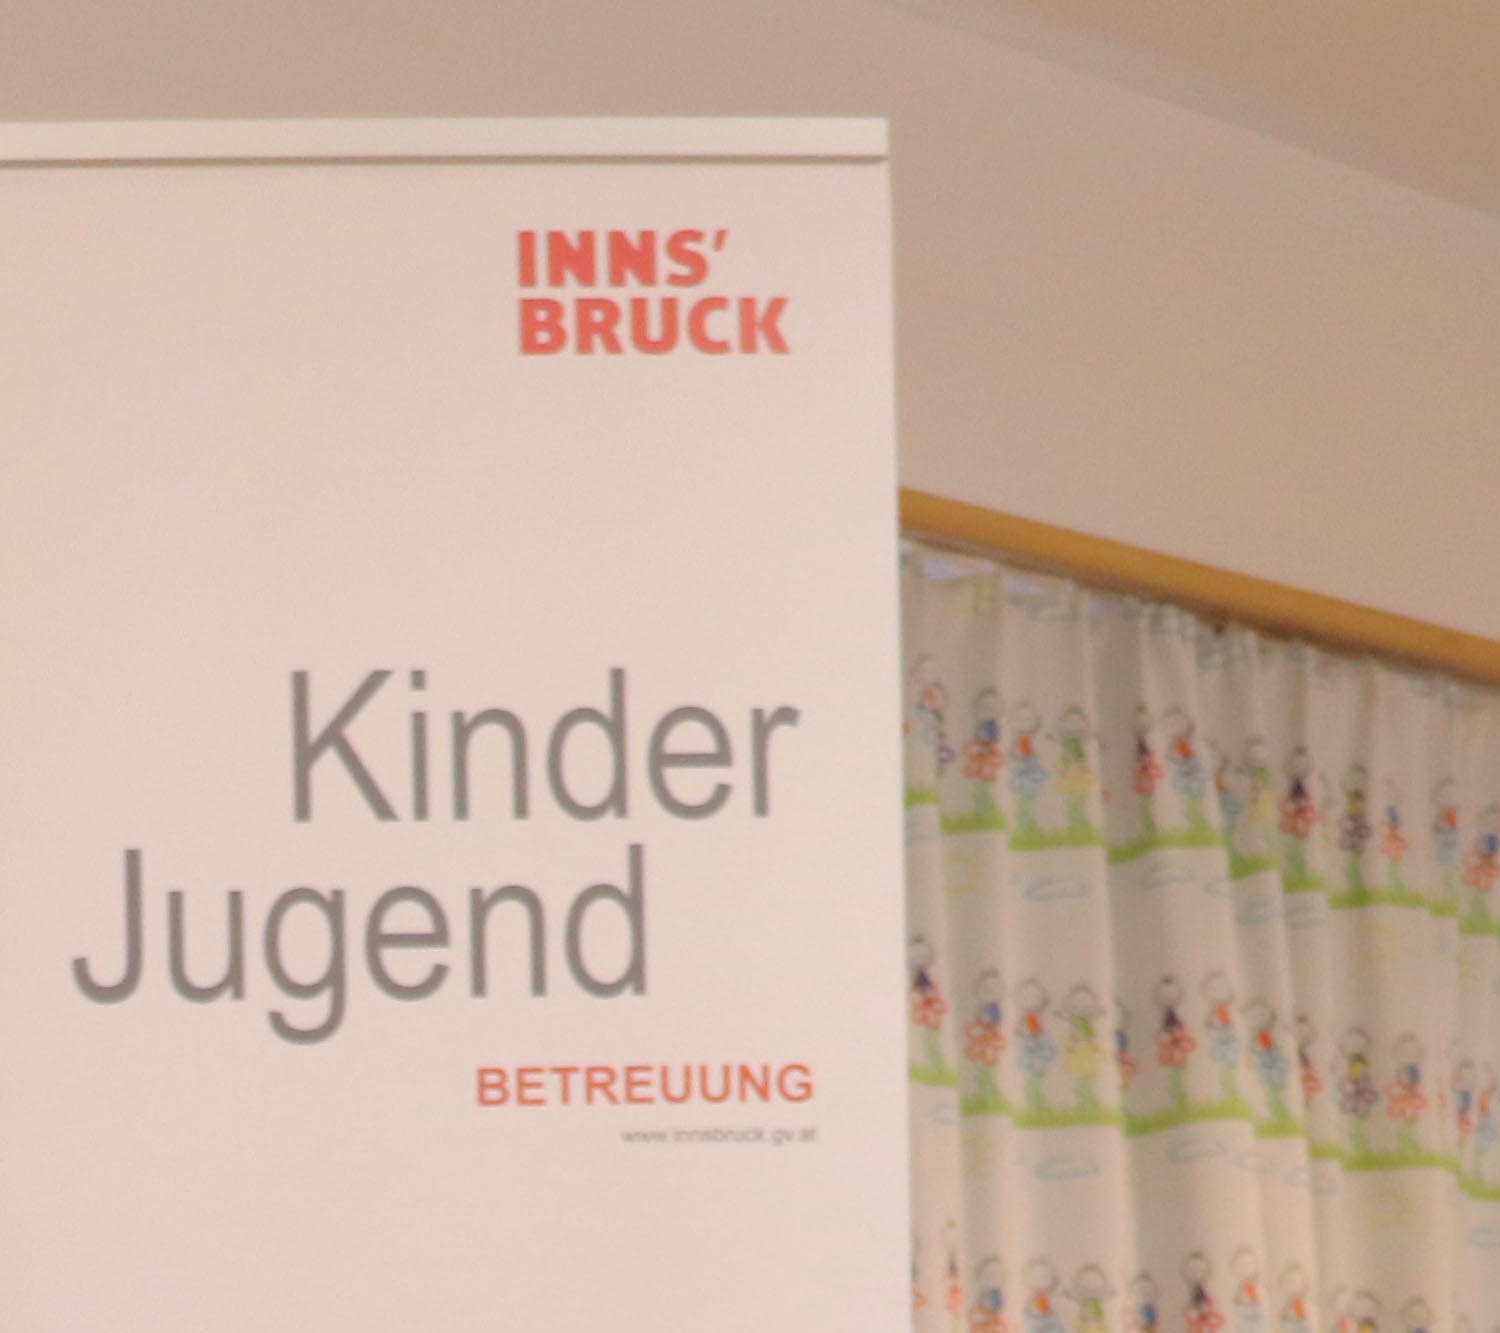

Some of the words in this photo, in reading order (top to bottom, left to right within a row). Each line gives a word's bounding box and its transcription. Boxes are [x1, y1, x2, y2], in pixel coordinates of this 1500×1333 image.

[518, 296, 790, 356] BRUCK
[290, 667, 800, 824] Kinder
[72, 844, 649, 1046] Jugend
[476, 1063, 815, 1107] BETREUUNG
